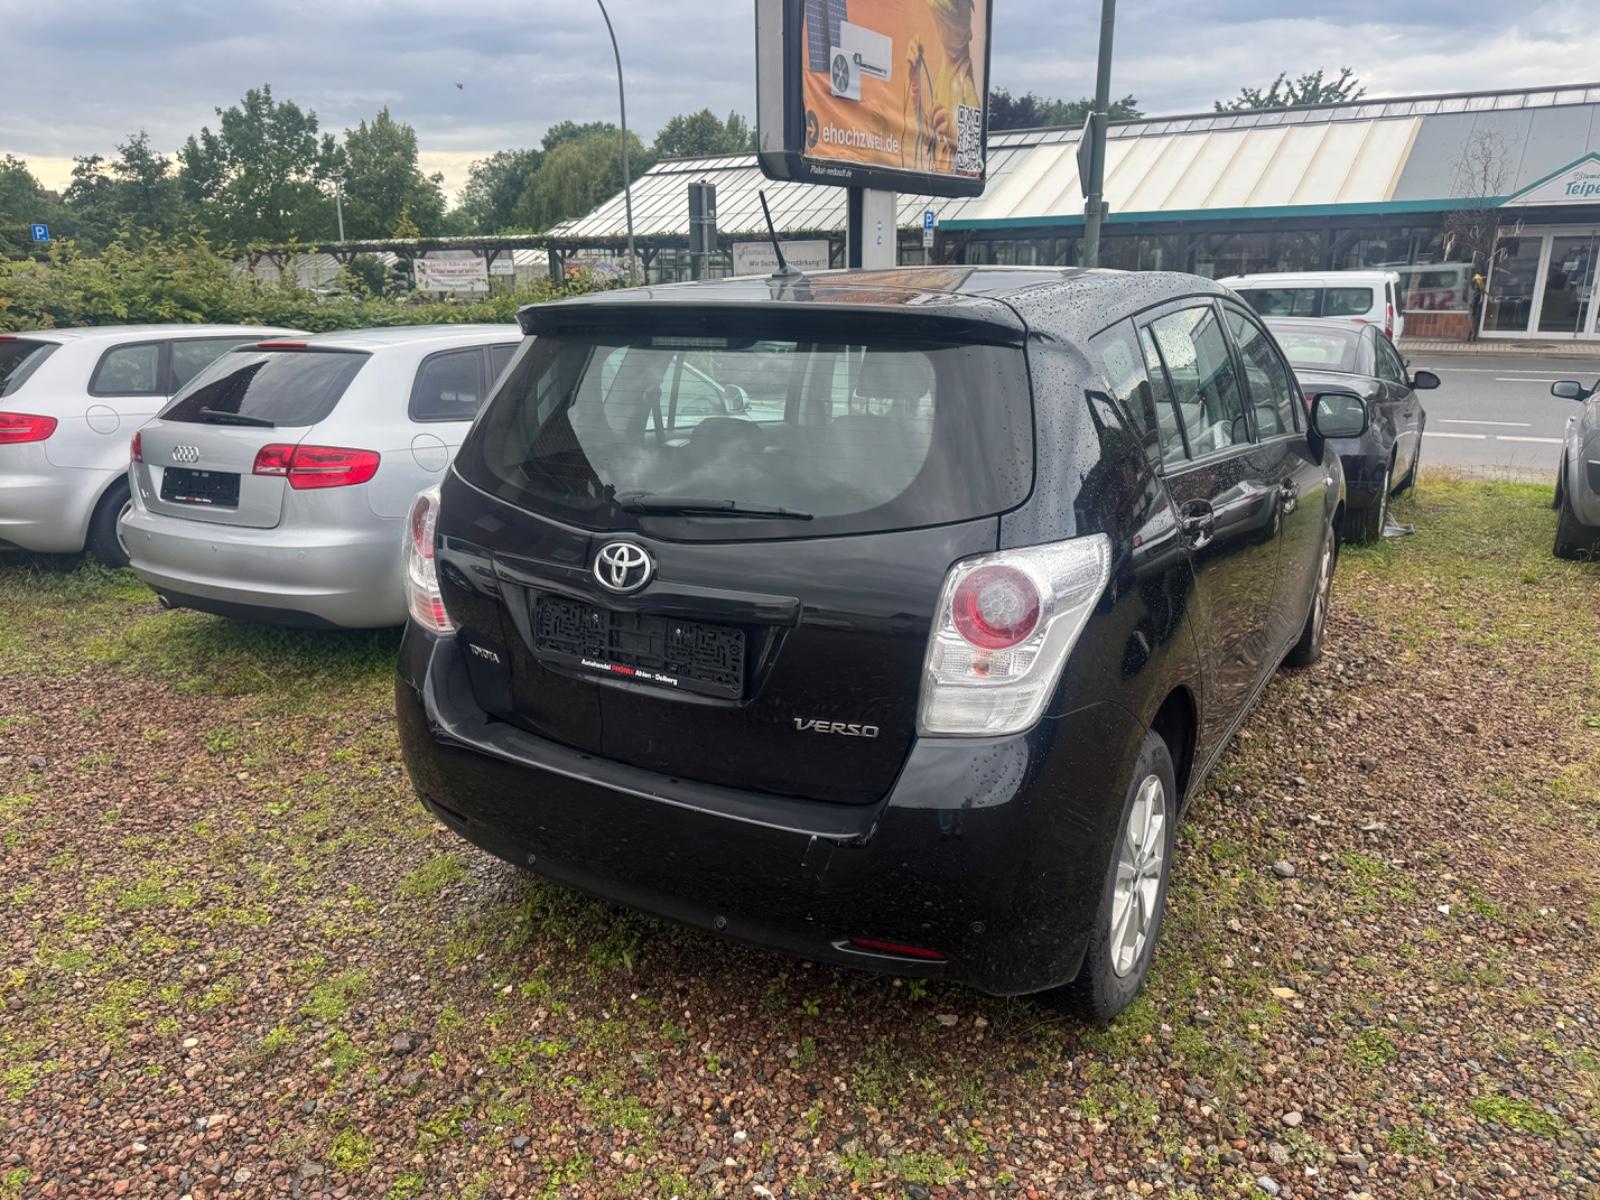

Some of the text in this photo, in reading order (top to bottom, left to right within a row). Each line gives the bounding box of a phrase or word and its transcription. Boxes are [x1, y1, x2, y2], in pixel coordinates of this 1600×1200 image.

[822, 124, 899, 153] ehochzwei.de
[35, 226, 45, 240] P
[793, 717, 880, 738] VERSO
